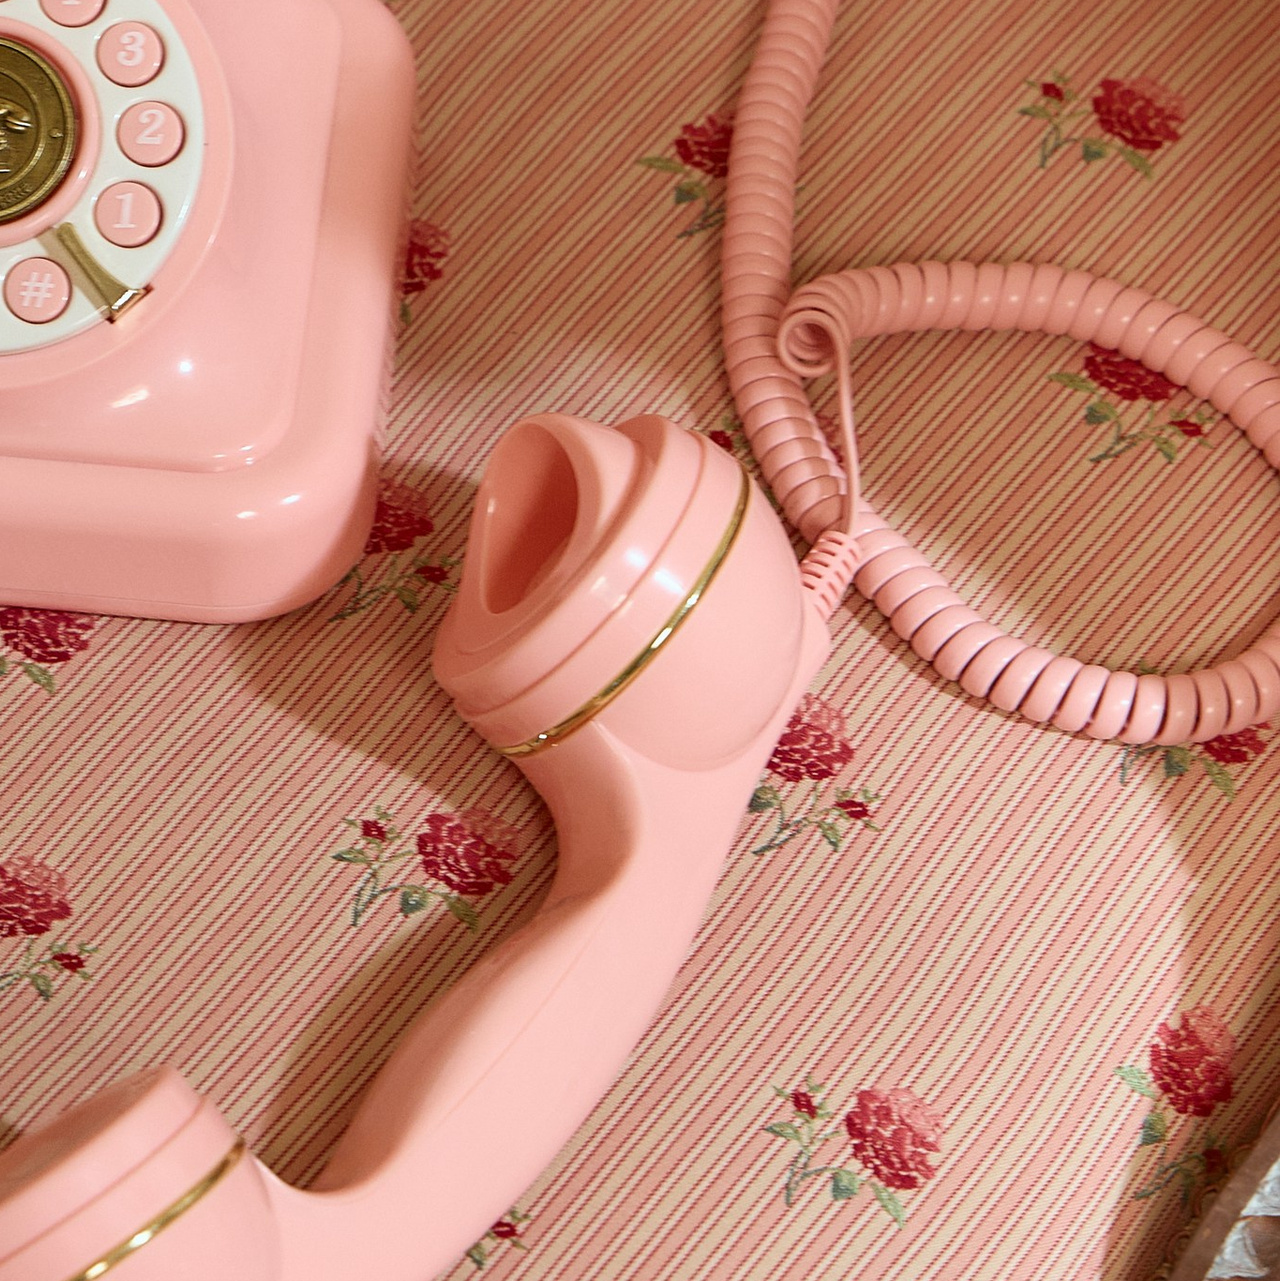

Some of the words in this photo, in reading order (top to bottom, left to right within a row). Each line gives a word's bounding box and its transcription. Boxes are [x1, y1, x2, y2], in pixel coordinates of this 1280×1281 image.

[117, 31, 146, 67] 3
[136, 109, 166, 145] 2
[113, 192, 137, 229] 1
[20, 271, 55, 308] #
